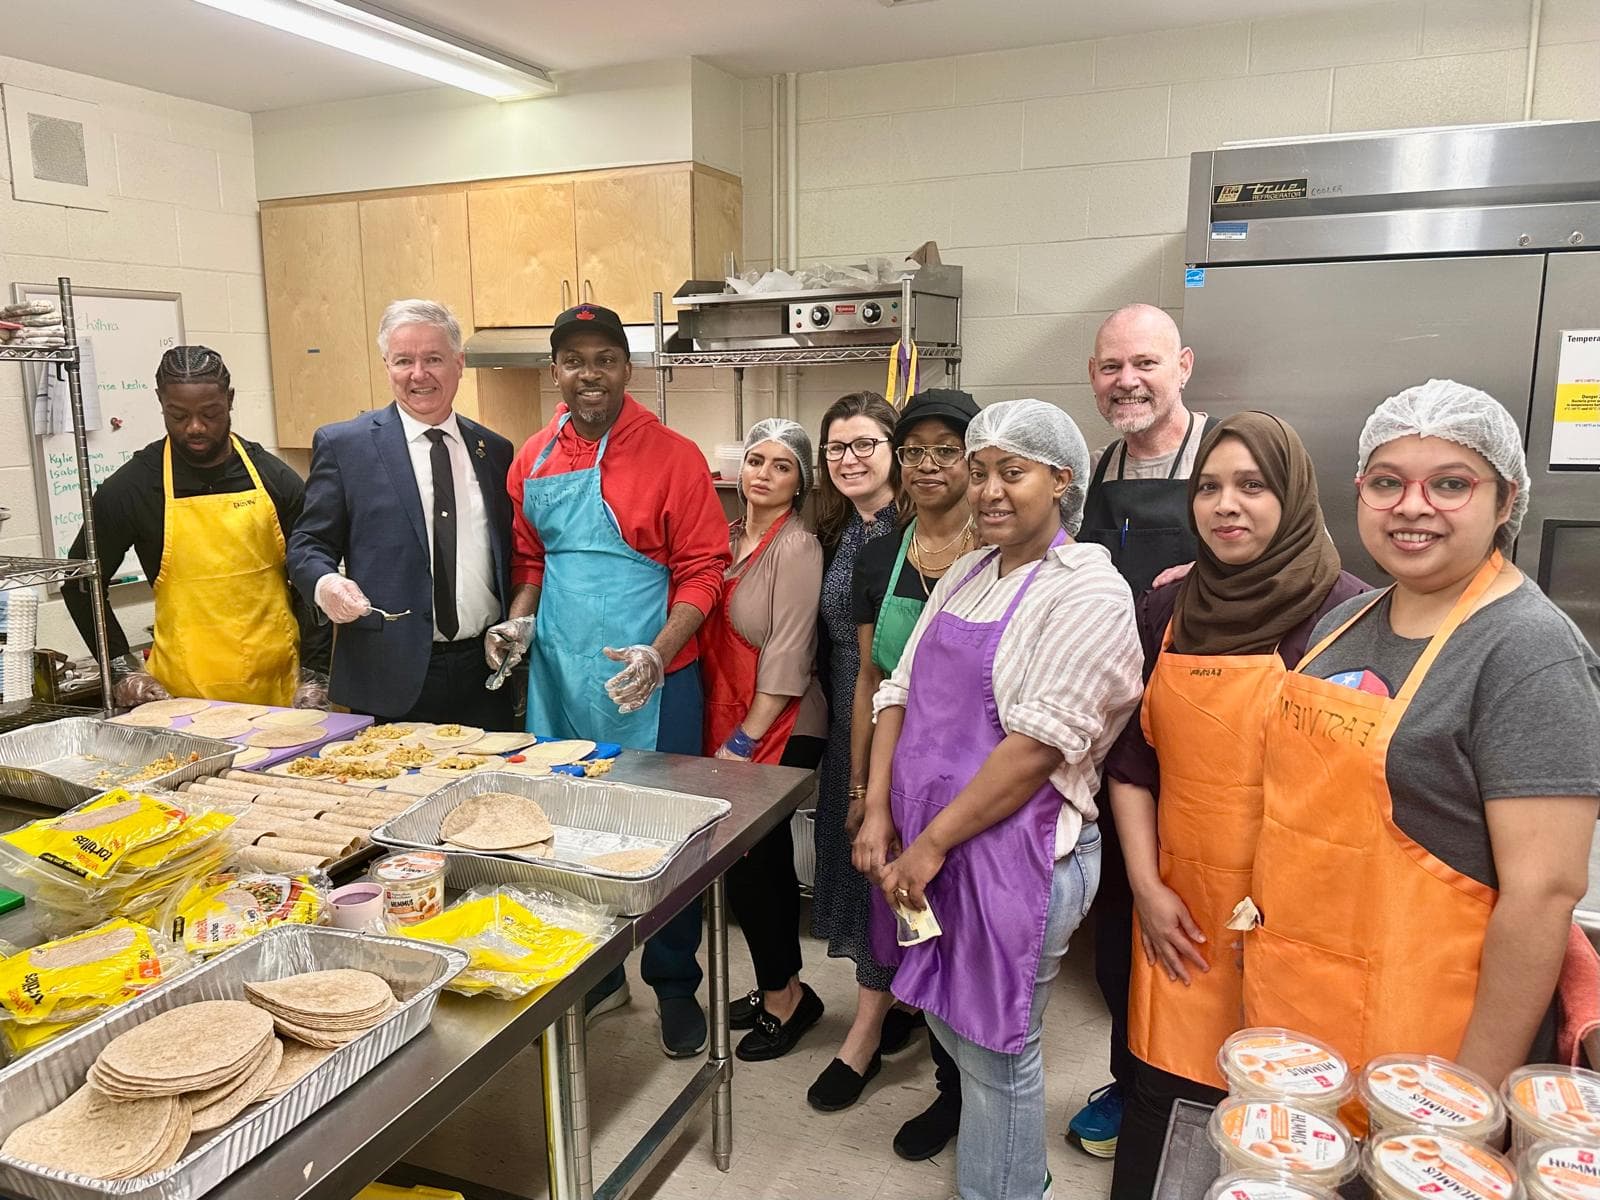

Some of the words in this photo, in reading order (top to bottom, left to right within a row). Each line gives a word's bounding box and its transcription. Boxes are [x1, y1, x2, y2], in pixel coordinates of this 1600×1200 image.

[1252, 191, 1302, 201] REFRIGERATOR
[159, 337, 174, 348] 105
[49, 453, 73, 469] Kylie
[72, 834, 113, 862] tortillas
[1287, 1061, 1337, 1077] HUMMUS
[1408, 1093, 1467, 1123] HUMMUS
[1290, 1113, 1308, 1146] HUMMUS
[1548, 1156, 1600, 1177] HUMM
